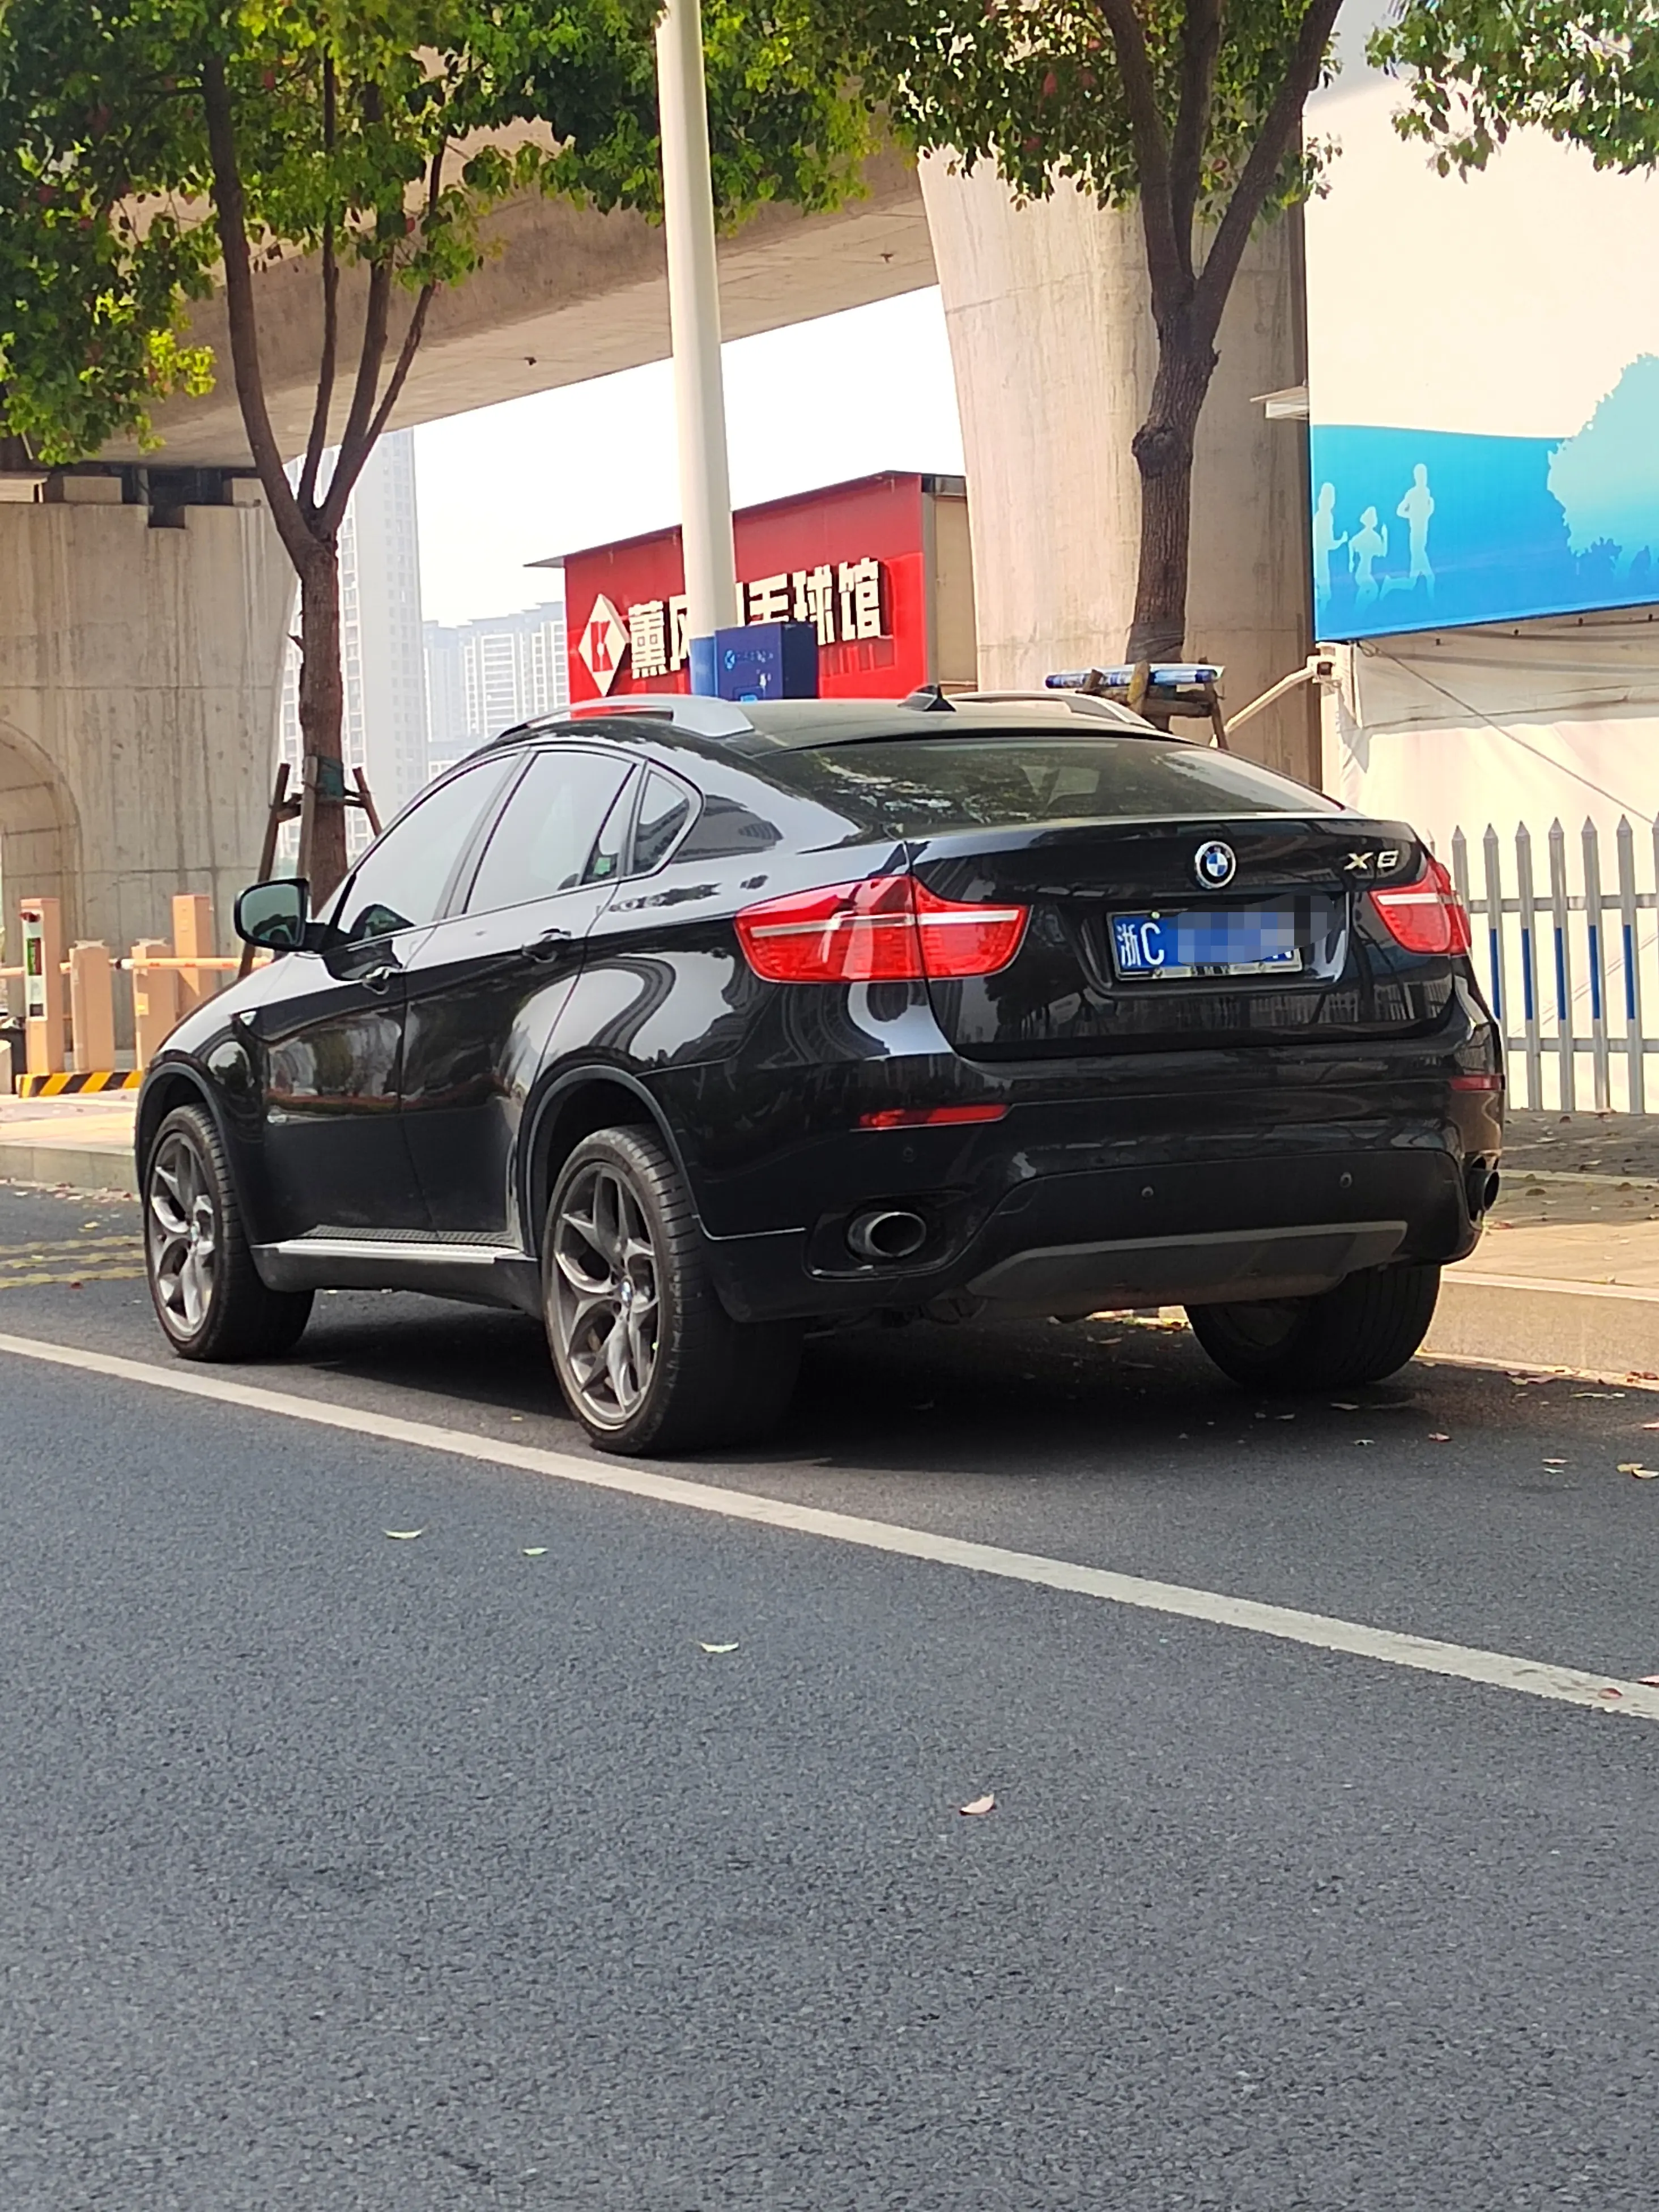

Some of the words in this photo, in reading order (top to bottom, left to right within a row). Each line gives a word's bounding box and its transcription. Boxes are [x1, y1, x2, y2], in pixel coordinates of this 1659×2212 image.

[628, 556, 882, 680] 薰风毛球馆
